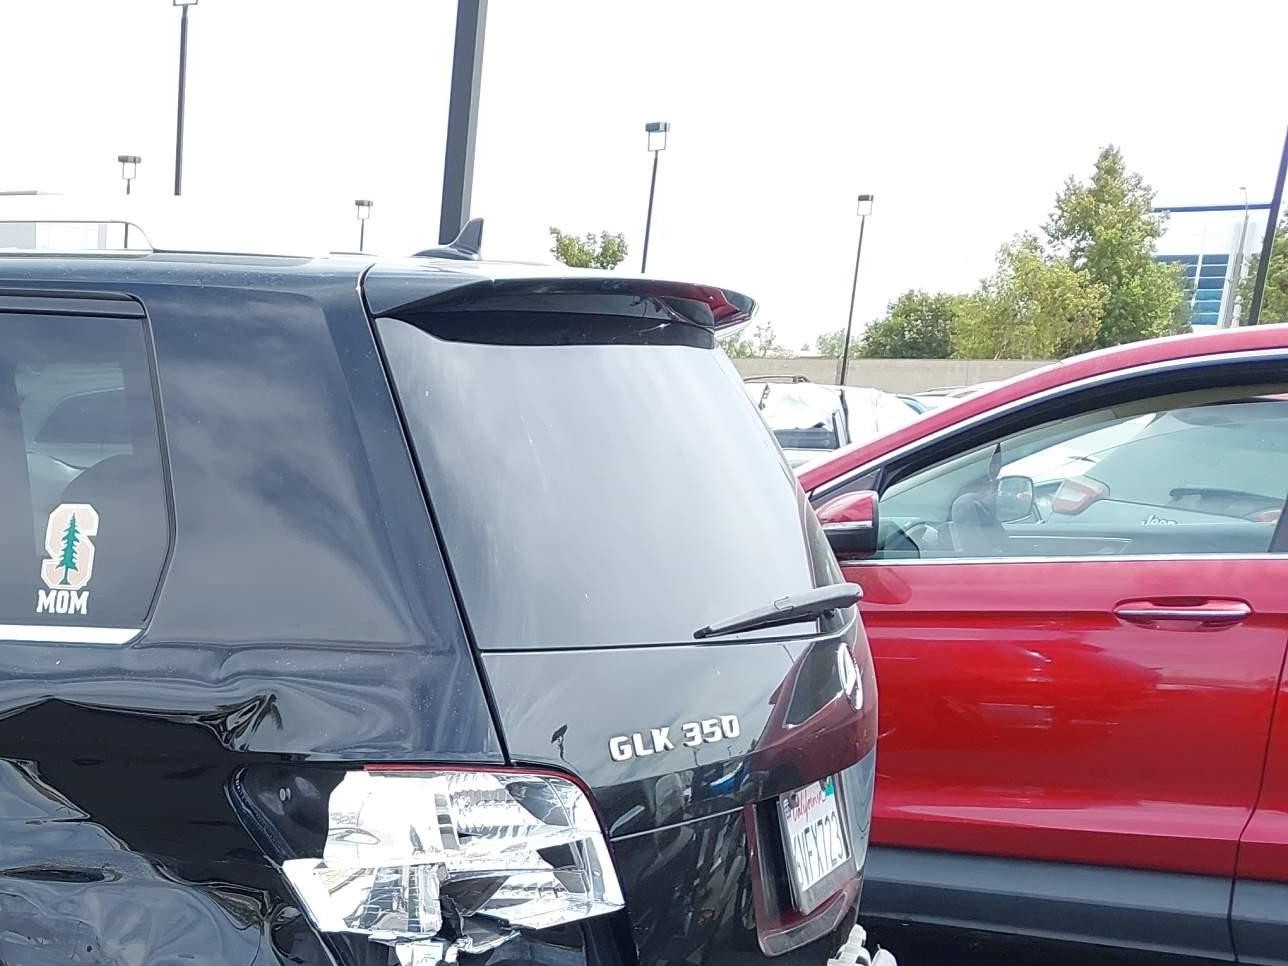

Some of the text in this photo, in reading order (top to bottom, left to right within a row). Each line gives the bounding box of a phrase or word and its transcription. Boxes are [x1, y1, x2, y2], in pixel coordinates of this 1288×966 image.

[36, 589, 90, 615] MOM
[608, 714, 741, 763] GLK 350
